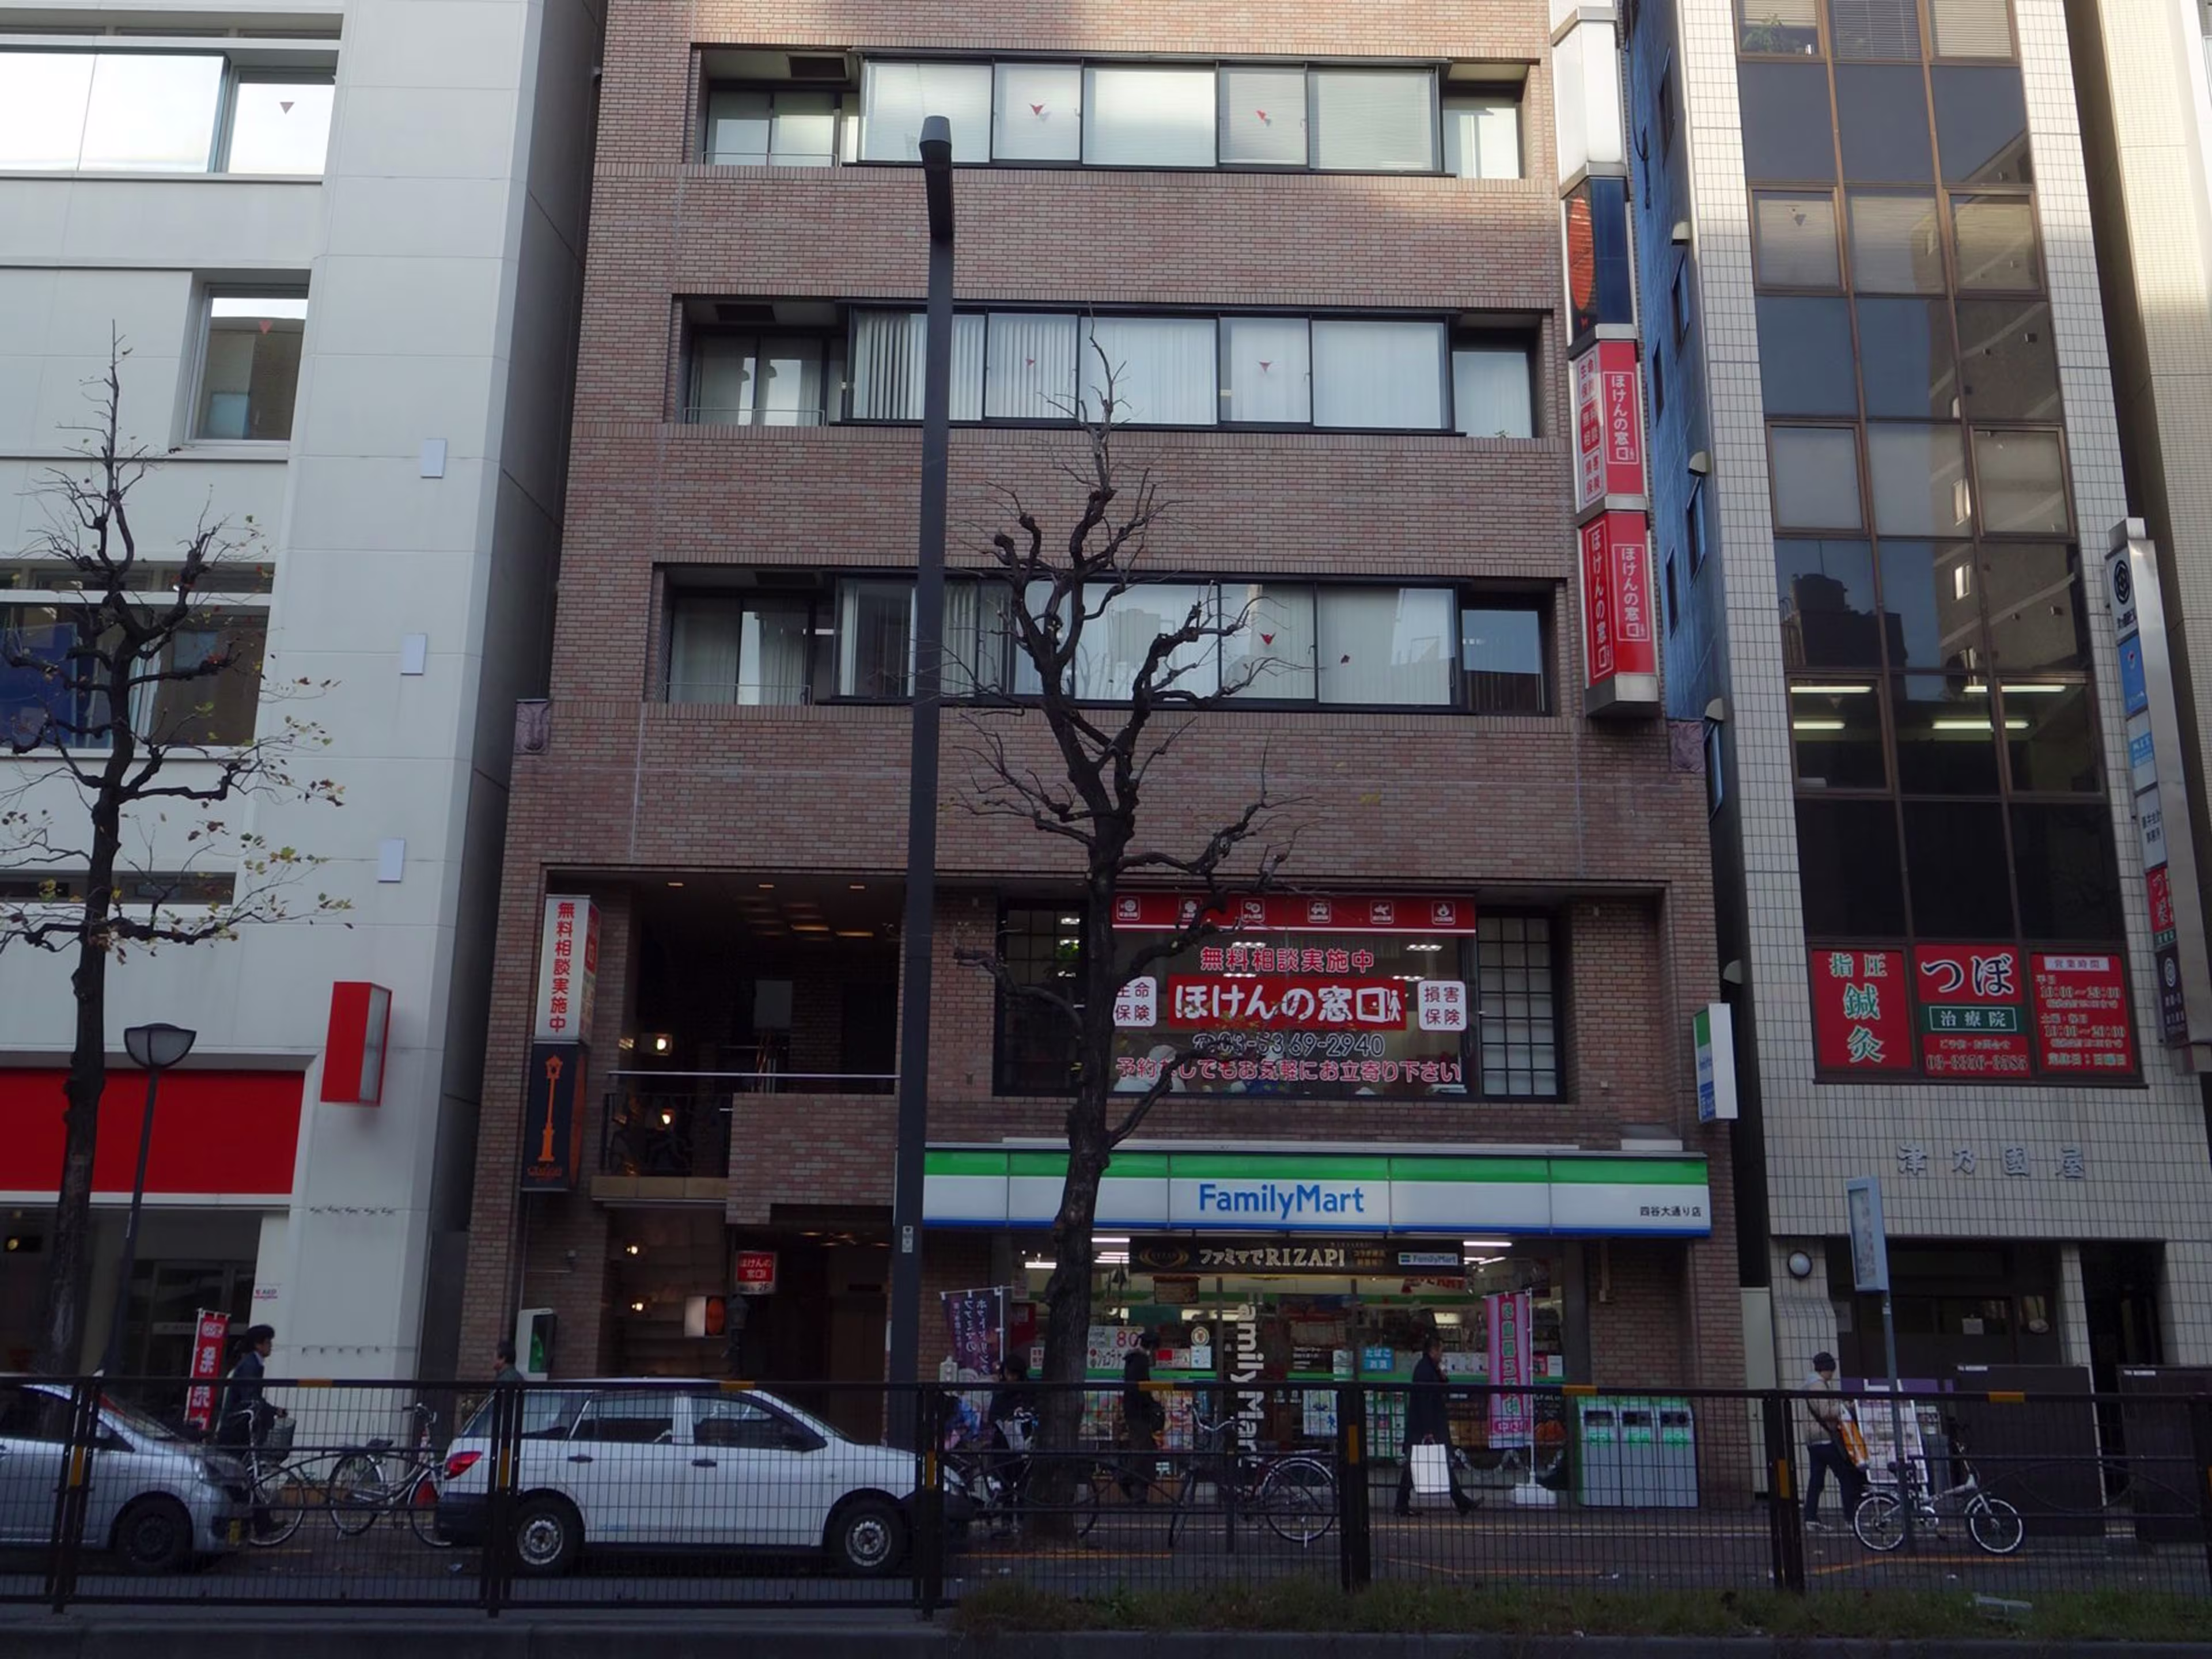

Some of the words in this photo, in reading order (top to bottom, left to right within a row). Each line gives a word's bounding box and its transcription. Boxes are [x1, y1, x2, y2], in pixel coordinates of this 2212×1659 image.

[1611, 375, 1630, 460] ほけんの窓口
[1592, 529, 1608, 668] ほけんの窓口
[1622, 547, 1640, 637] ほけんの窓口
[550, 902, 574, 1033] 無料相談実施中
[1200, 946, 1374, 974] 無料相談実施中
[1830, 952, 1888, 978] 指圧
[2055, 959, 2100, 969] 営業時間
[1921, 952, 2014, 997] つぼ
[1175, 983, 1390, 1024] ほけんの窓口
[1425, 986, 1459, 1003] 損害
[1116, 1005, 1150, 1021] 保険
[1426, 1008, 1460, 1025] 保険
[1843, 982, 1885, 1063] 鍼灸
[1940, 1009, 2007, 1028] 治療院
[1199, 1184, 1364, 1220] FamilyMart
[1640, 1206, 1701, 1217] 四谷大通り店
[1412, 1255, 1456, 1264] FamilyMart
